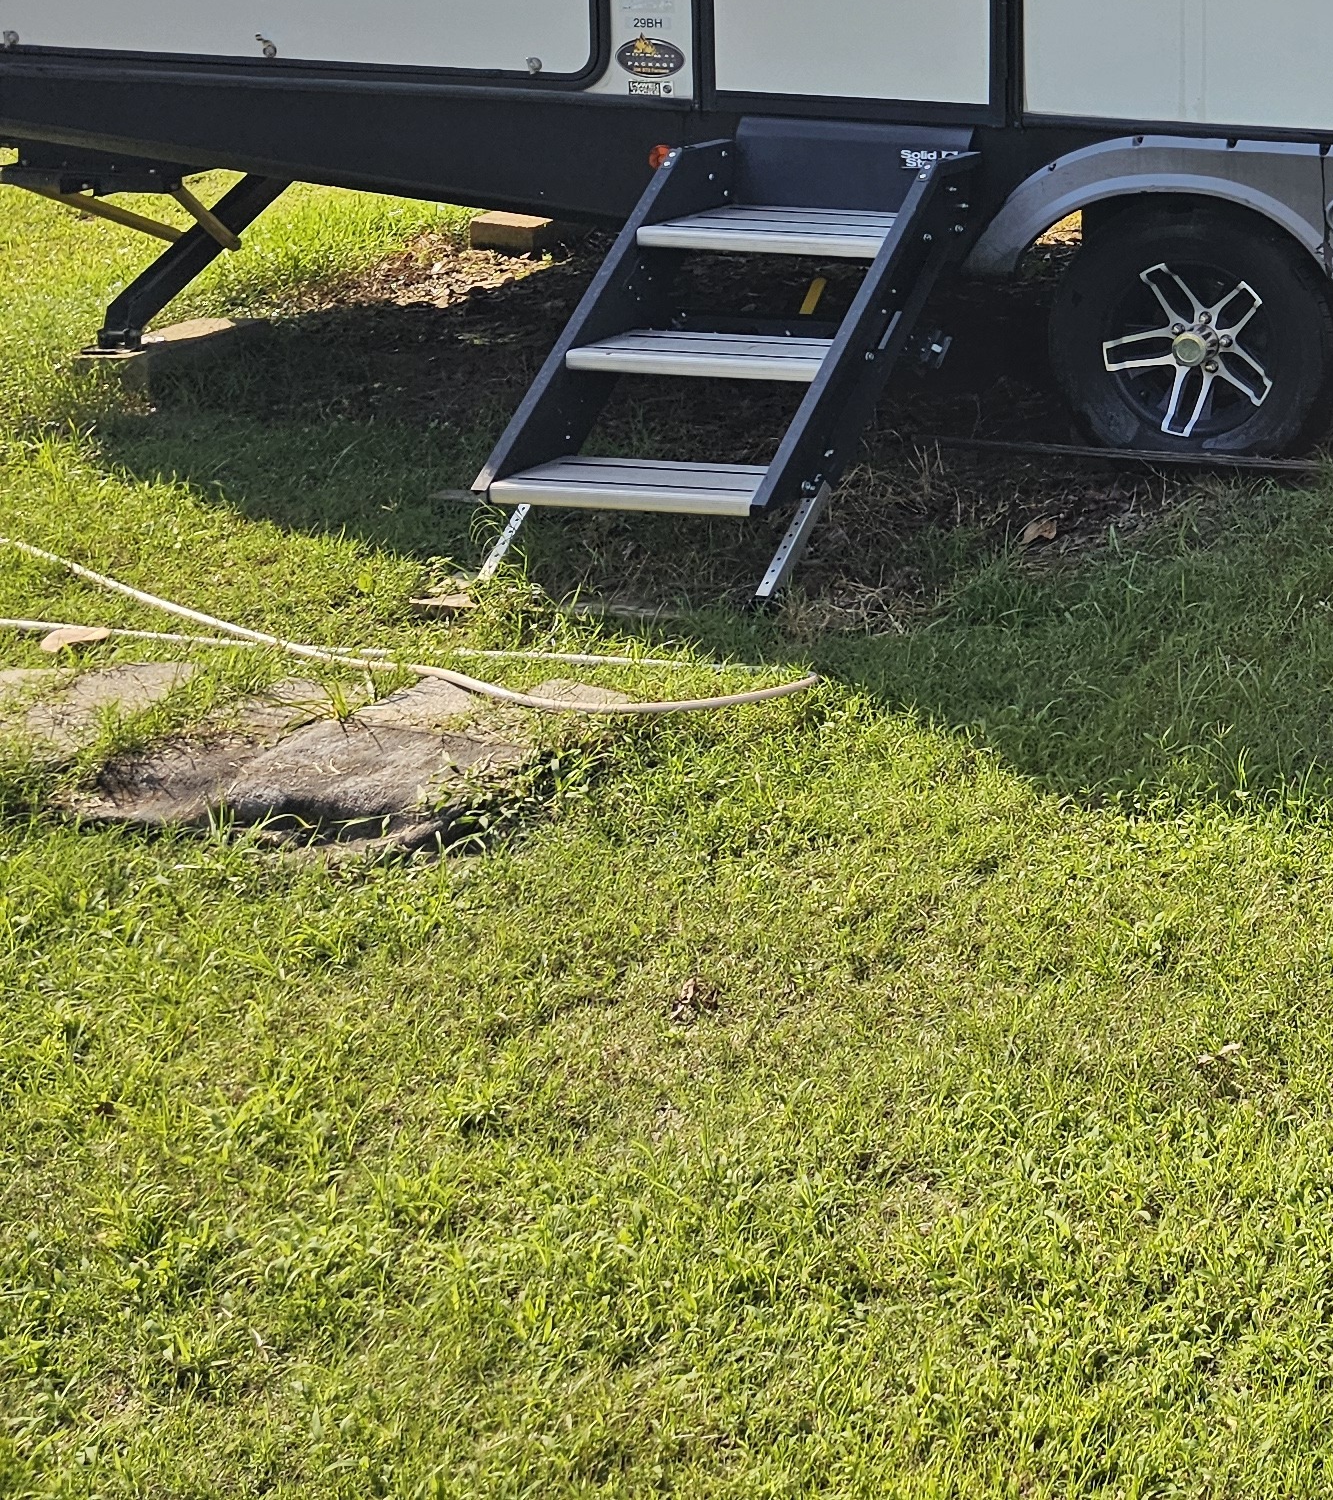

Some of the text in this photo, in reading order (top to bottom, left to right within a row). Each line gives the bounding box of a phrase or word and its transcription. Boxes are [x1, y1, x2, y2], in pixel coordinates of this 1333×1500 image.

[633, 18, 663, 29] 29BH
[900, 149, 938, 160] Solid
[905, 157, 926, 168] St
